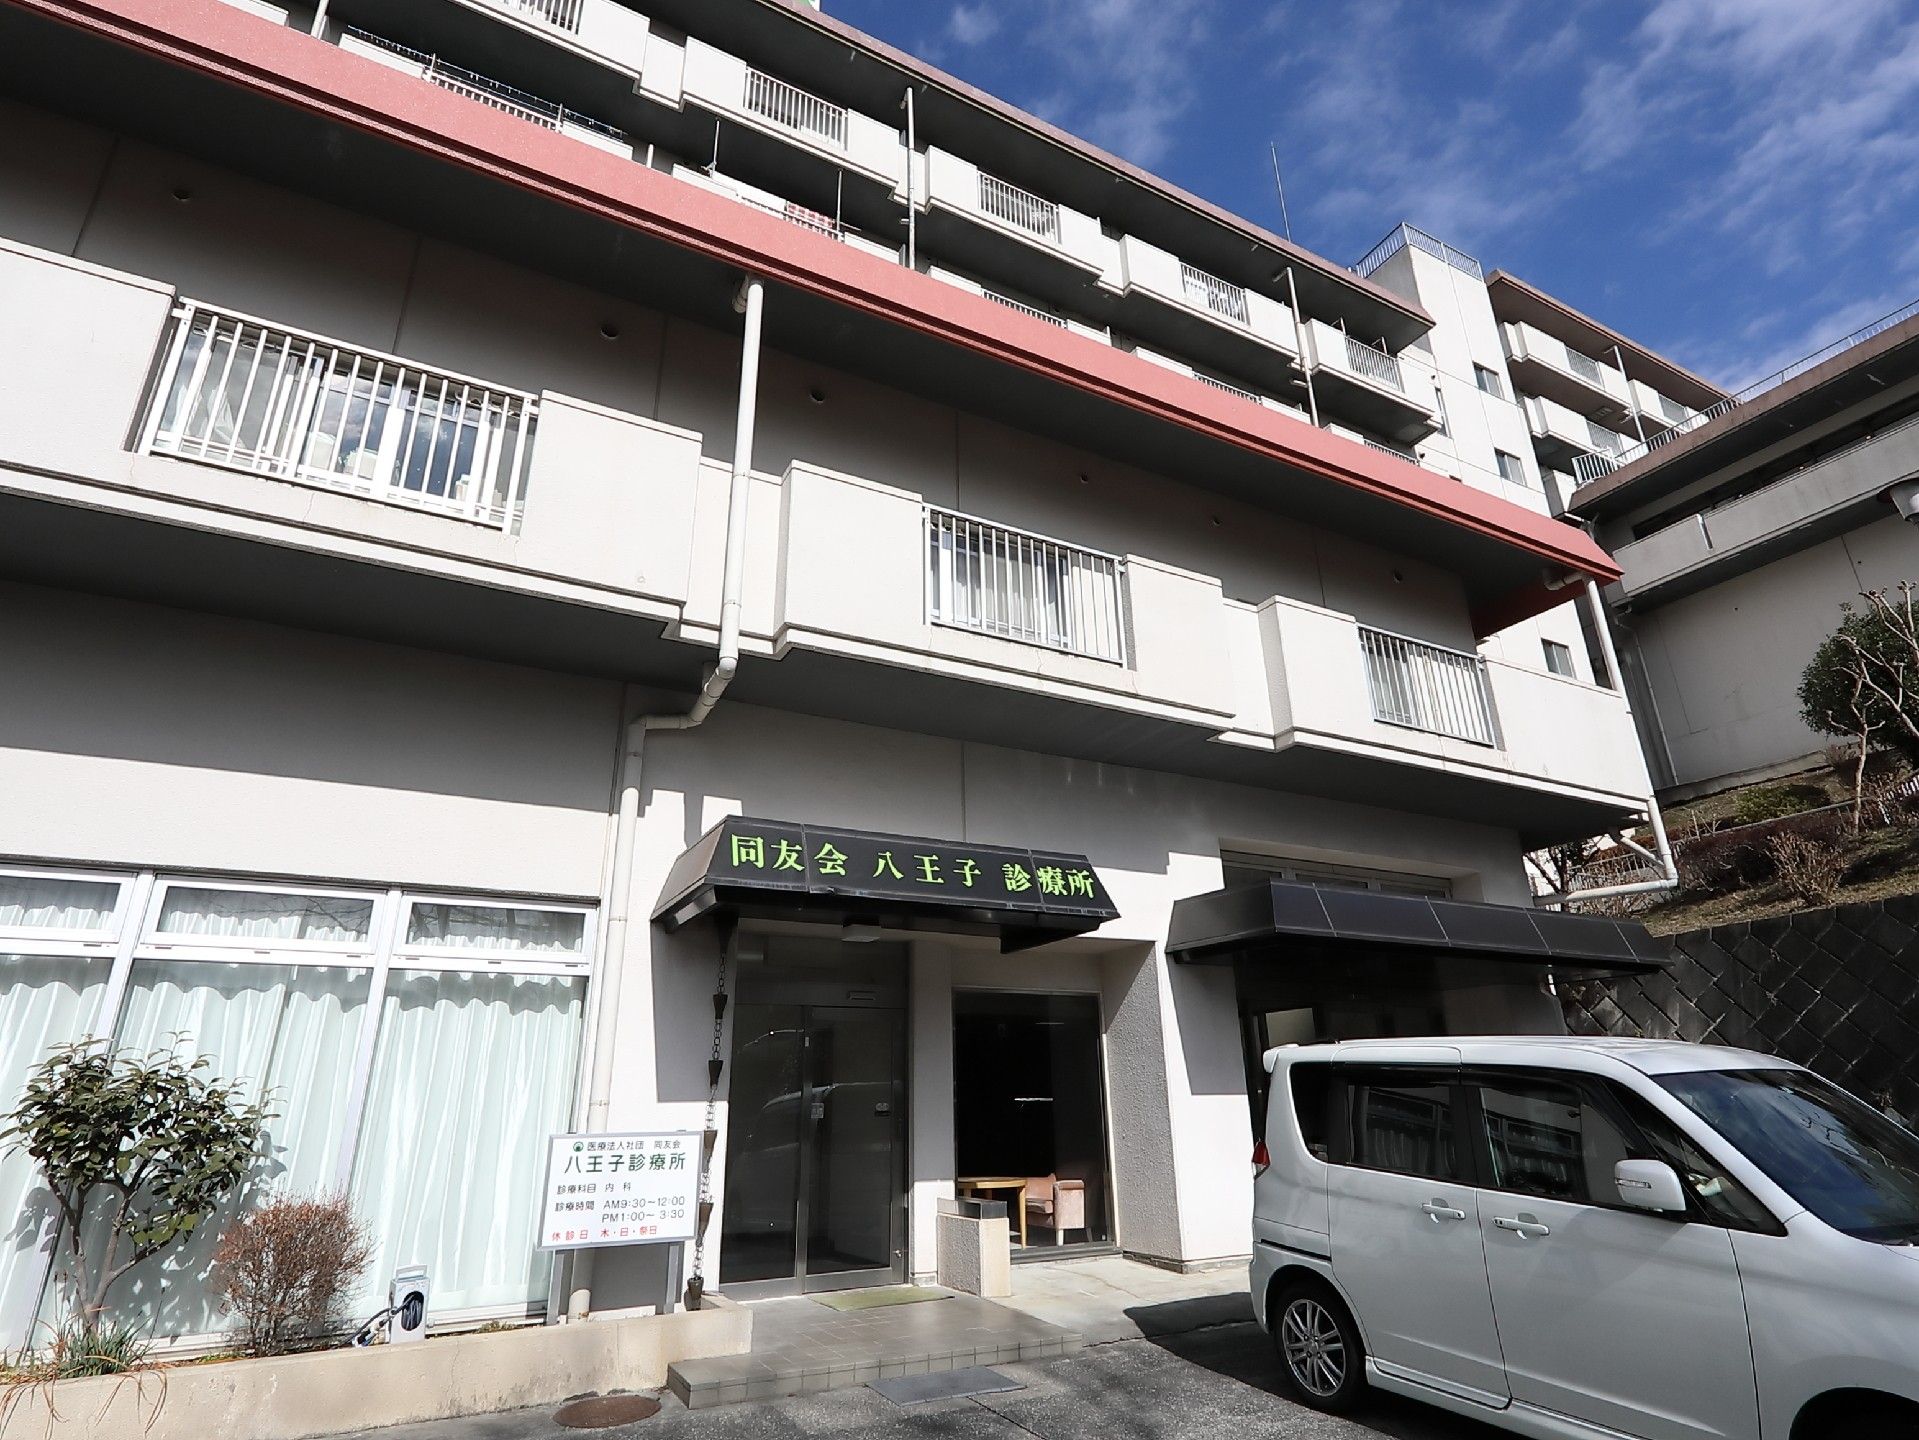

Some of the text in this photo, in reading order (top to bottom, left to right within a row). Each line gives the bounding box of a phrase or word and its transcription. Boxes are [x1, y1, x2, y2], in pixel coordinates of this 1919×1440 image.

[731, 833, 1094, 899] 同友会 八王子 診療所
[587, 1139, 681, 1152] 医療法人社団 同友会
[564, 1152, 686, 1174] 八王子診療所
[557, 1183, 597, 1195] 診療科目
[555, 1200, 595, 1212] 診療時間
